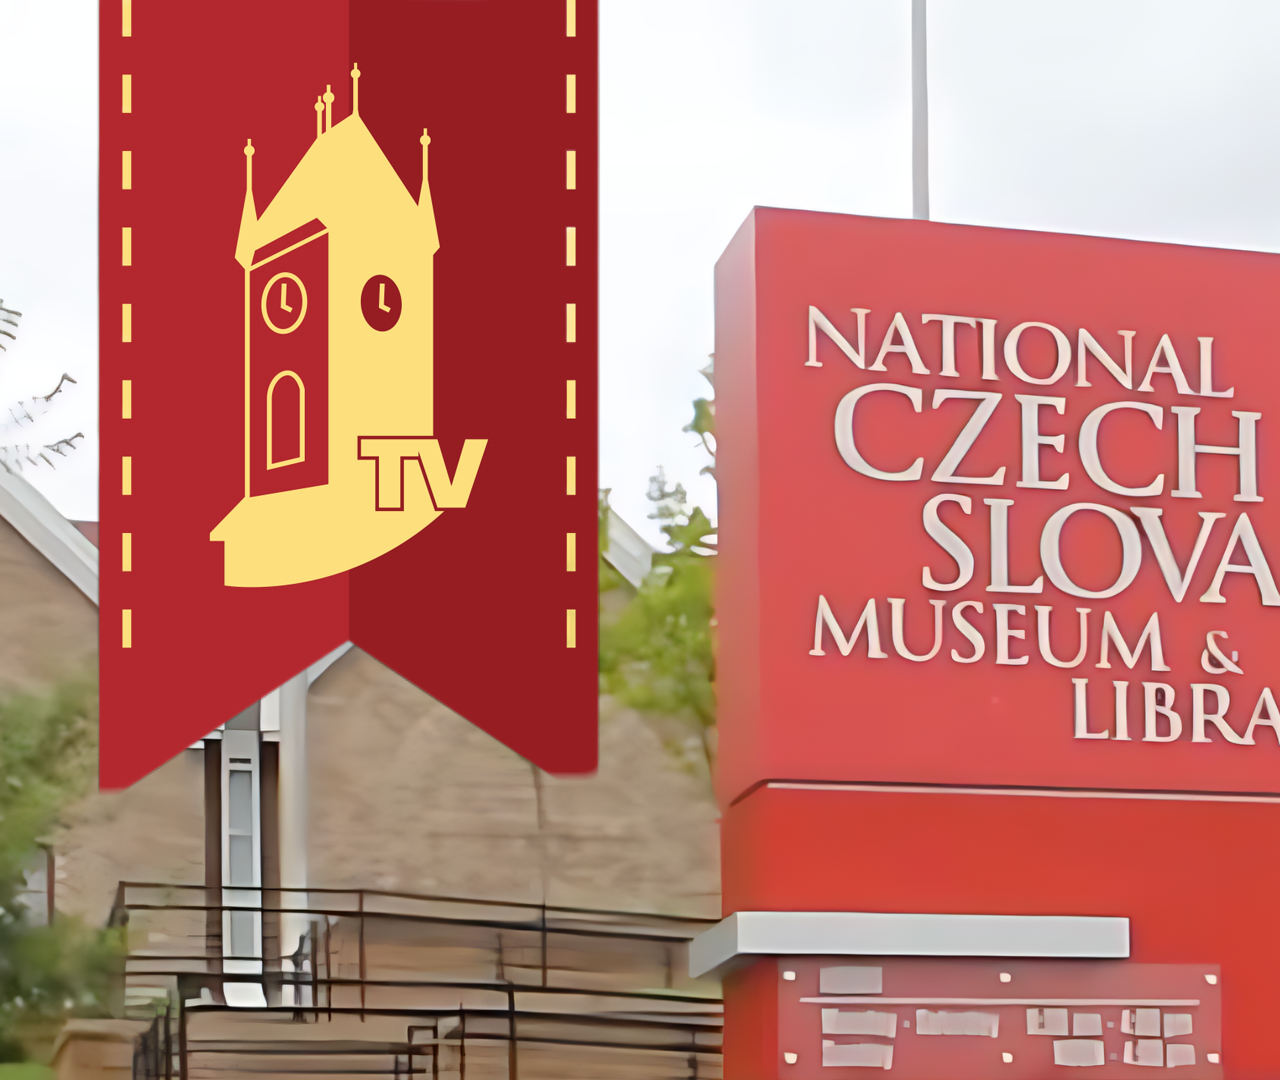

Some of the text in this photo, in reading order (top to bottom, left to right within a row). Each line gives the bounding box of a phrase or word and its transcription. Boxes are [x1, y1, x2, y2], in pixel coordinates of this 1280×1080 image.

[804, 305, 1235, 399] NATIONAL
[834, 383, 1265, 503] CZECH
[808, 595, 1244, 675] MUSEUM &
